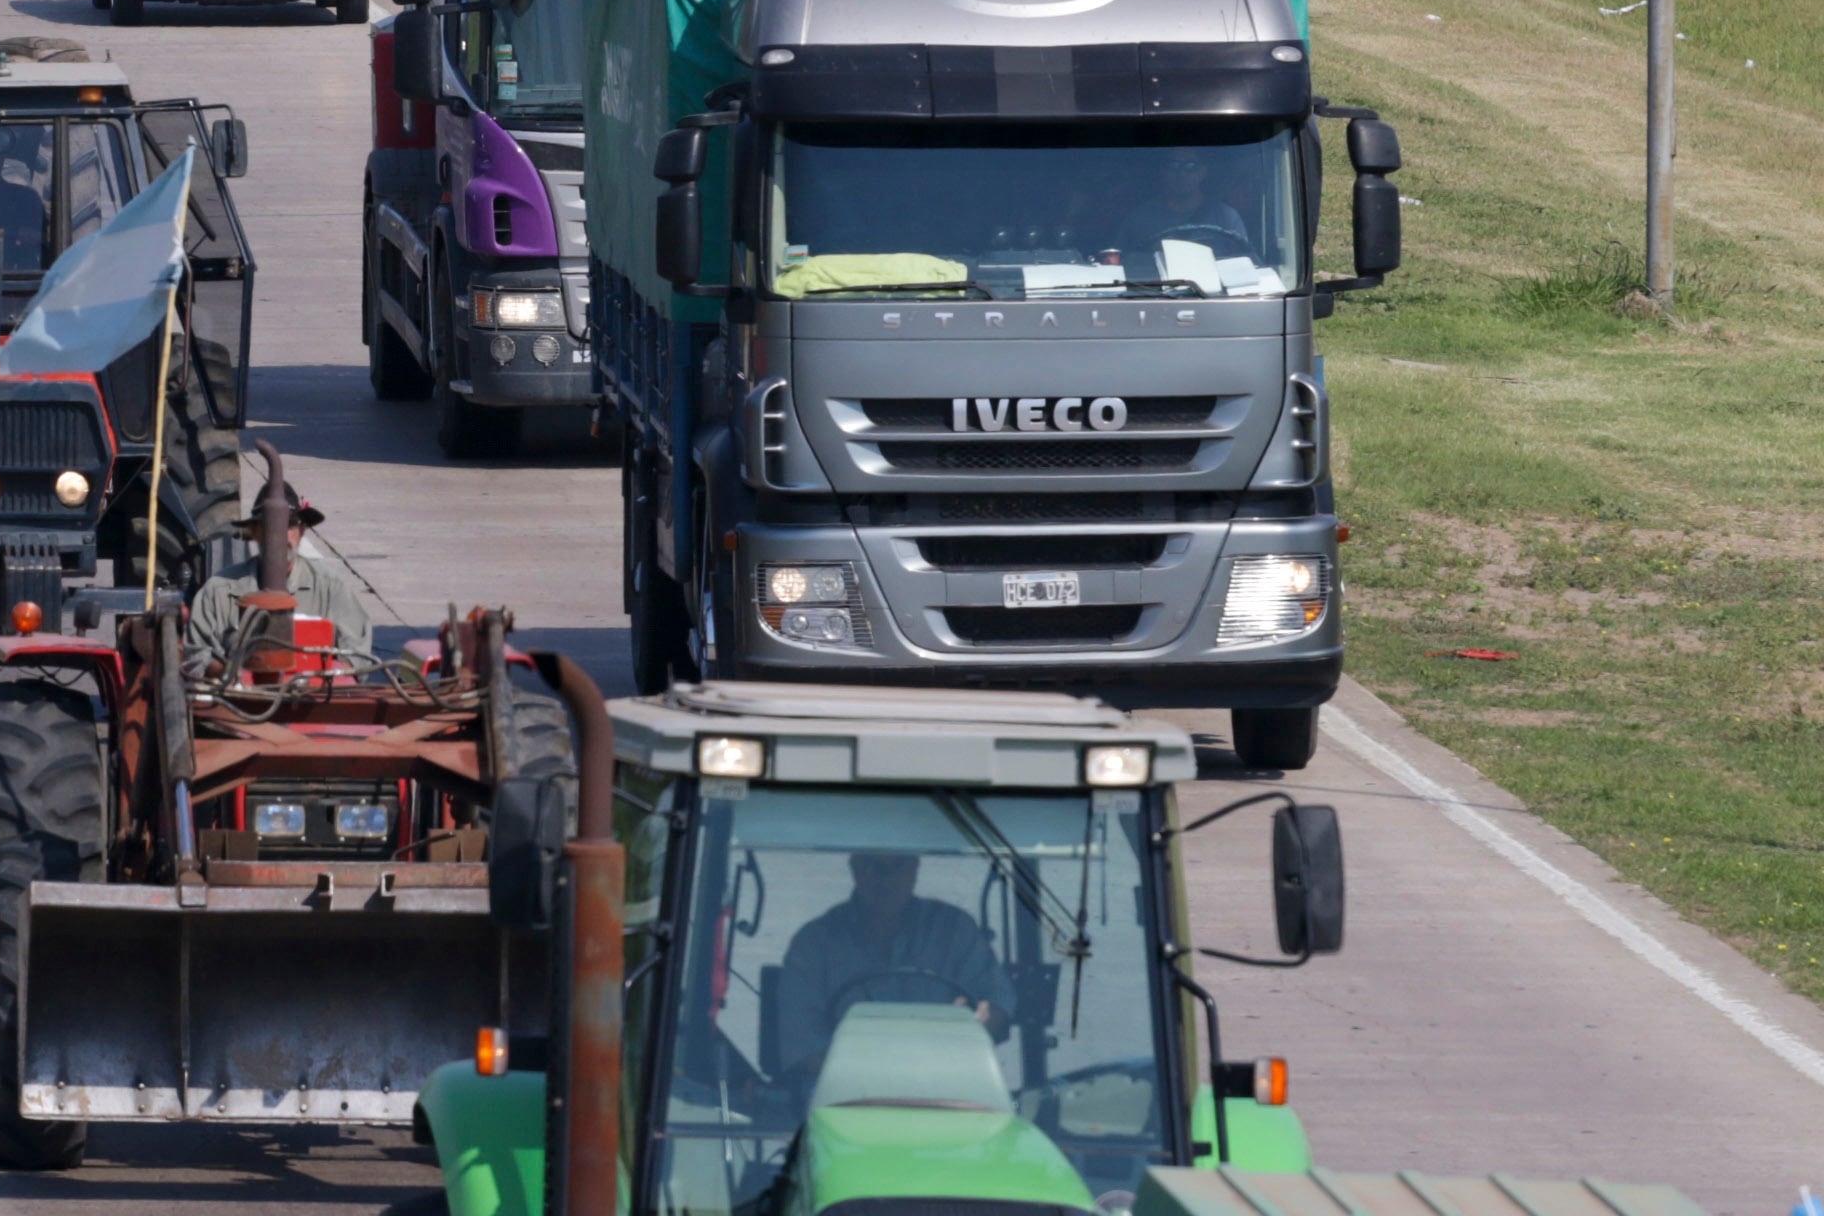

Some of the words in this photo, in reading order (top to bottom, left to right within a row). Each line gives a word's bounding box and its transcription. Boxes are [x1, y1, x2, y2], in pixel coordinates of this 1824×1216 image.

[882, 310, 1197, 329] STRALIS
[952, 397, 1127, 432] IVECO
[1006, 582, 1036, 602] HCE
[1046, 580, 1076, 601] 072
